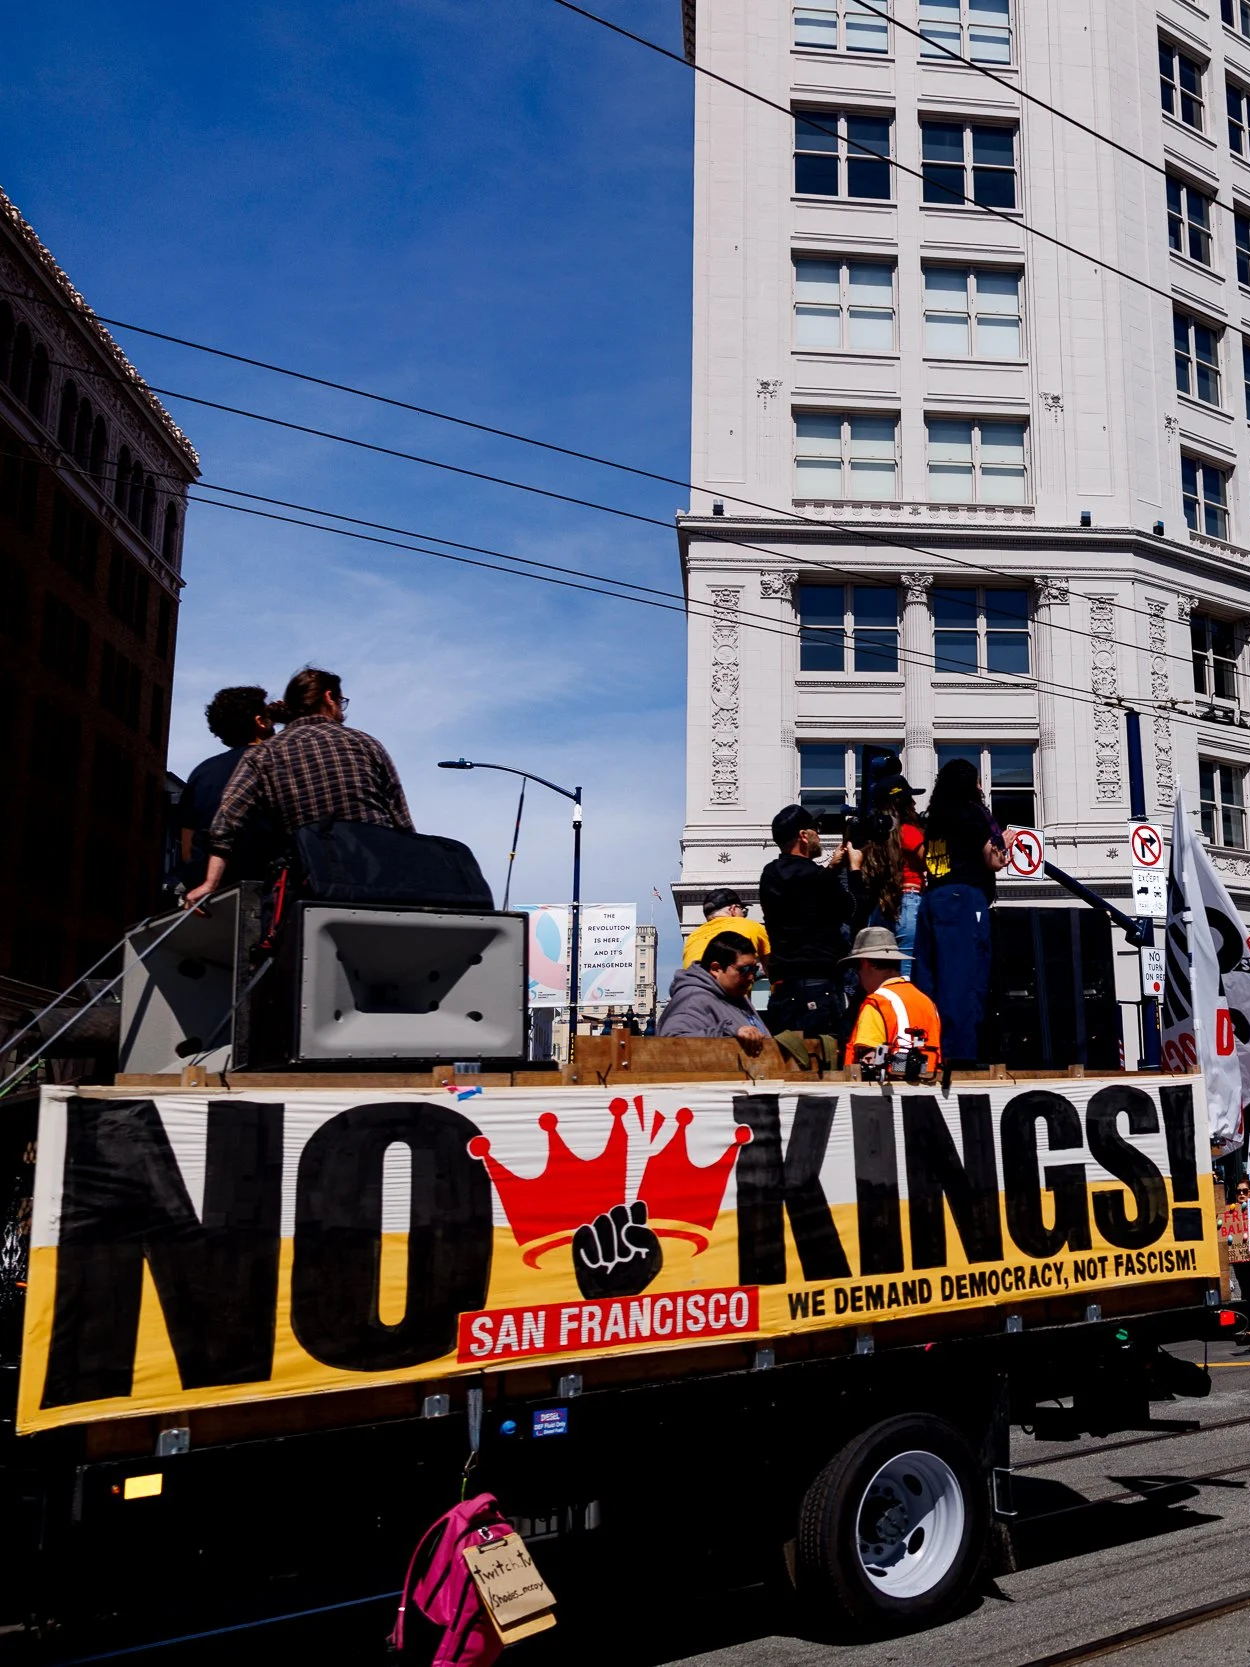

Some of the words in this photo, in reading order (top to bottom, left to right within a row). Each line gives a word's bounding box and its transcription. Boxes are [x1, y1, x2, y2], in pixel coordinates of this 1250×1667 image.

[1138, 874, 1160, 882] EXCEPT
[1149, 952, 1160, 962] NO
[1148, 964, 1163, 972] TURN
[1146, 973, 1154, 981] ON
[39, 1099, 494, 1409] NO
[733, 1084, 1204, 1286] KINGS!
[788, 1288, 826, 1320] WE
[834, 1279, 932, 1315] DEMAND
[944, 1263, 1070, 1304] DEMOCRACY,
[1073, 1256, 1106, 1281] NOT
[1114, 1248, 1197, 1278] FASCISM!
[469, 1315, 546, 1357] SAN
[559, 1291, 750, 1347] FRANCISCO
[541, 1412, 560, 1422] DIESEL
[473, 1550, 532, 1584] twitch.tv
